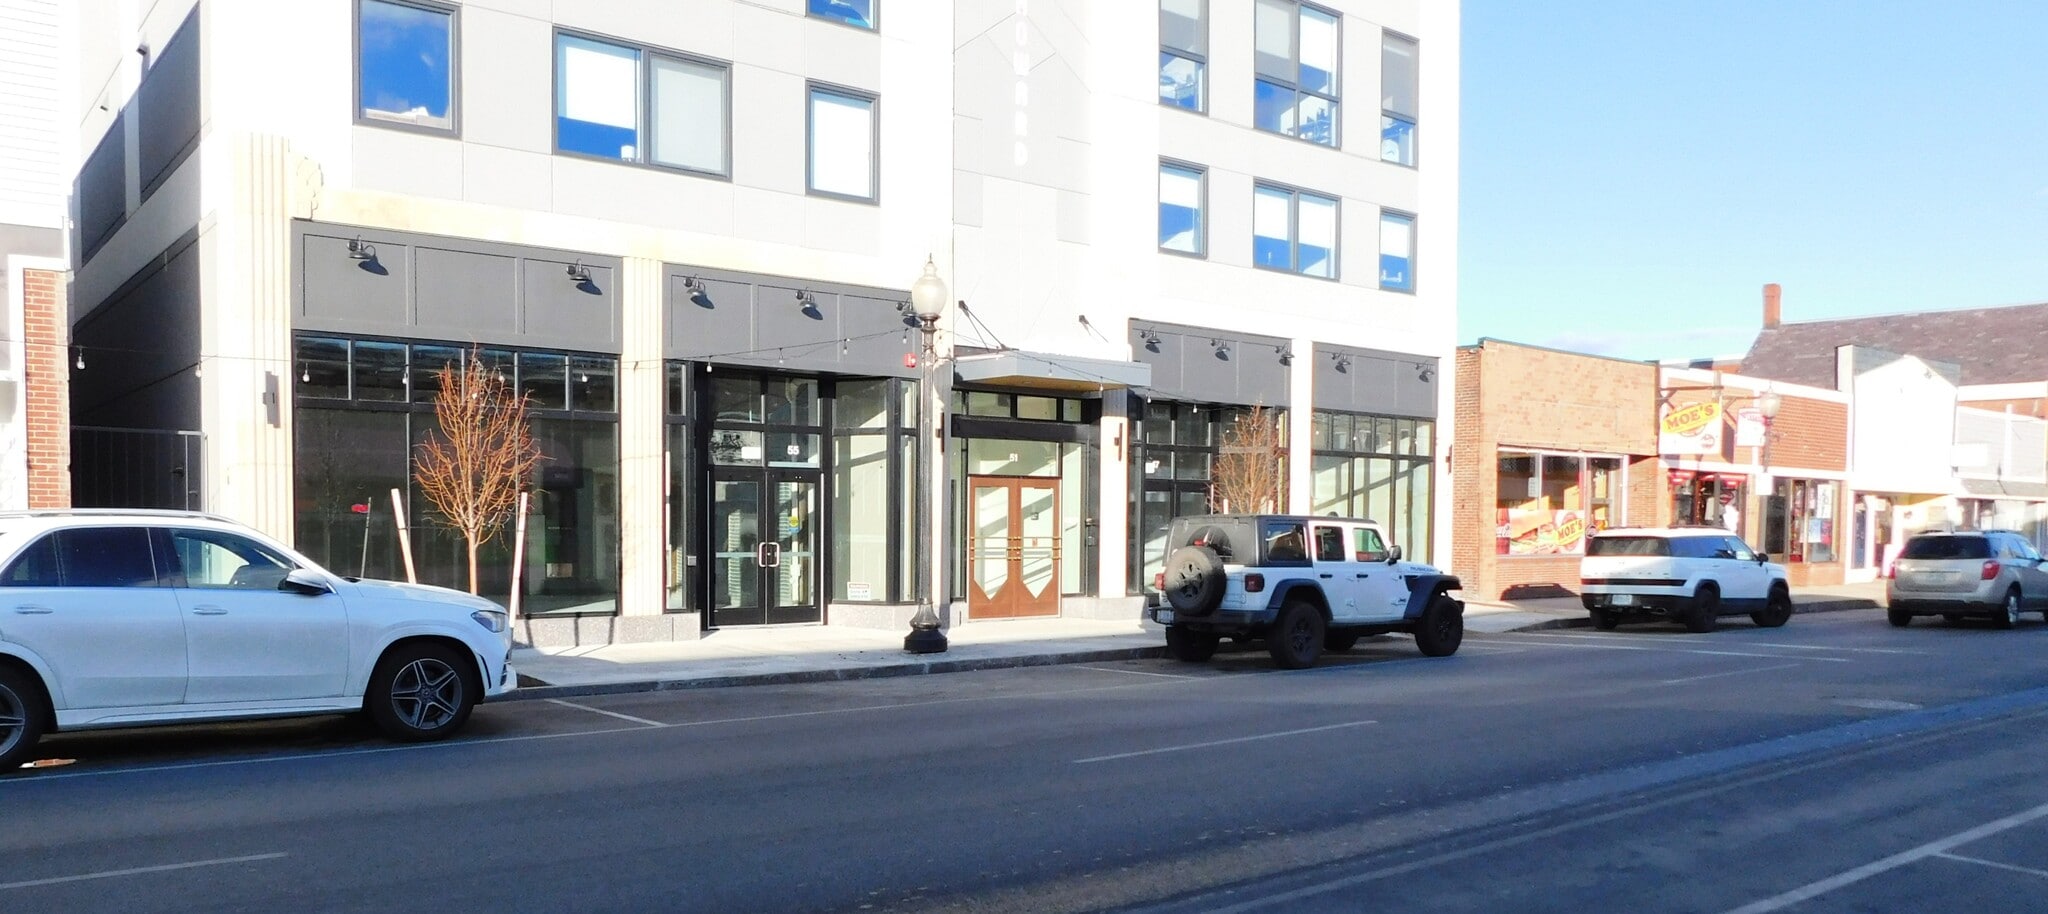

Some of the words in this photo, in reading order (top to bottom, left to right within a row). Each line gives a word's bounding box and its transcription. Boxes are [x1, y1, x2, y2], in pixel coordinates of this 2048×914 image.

[1666, 404, 1714, 430] MOE'S
[787, 445, 800, 455] 55
[1009, 453, 1018, 462] 51
[1557, 519, 1583, 540] MOE'S
